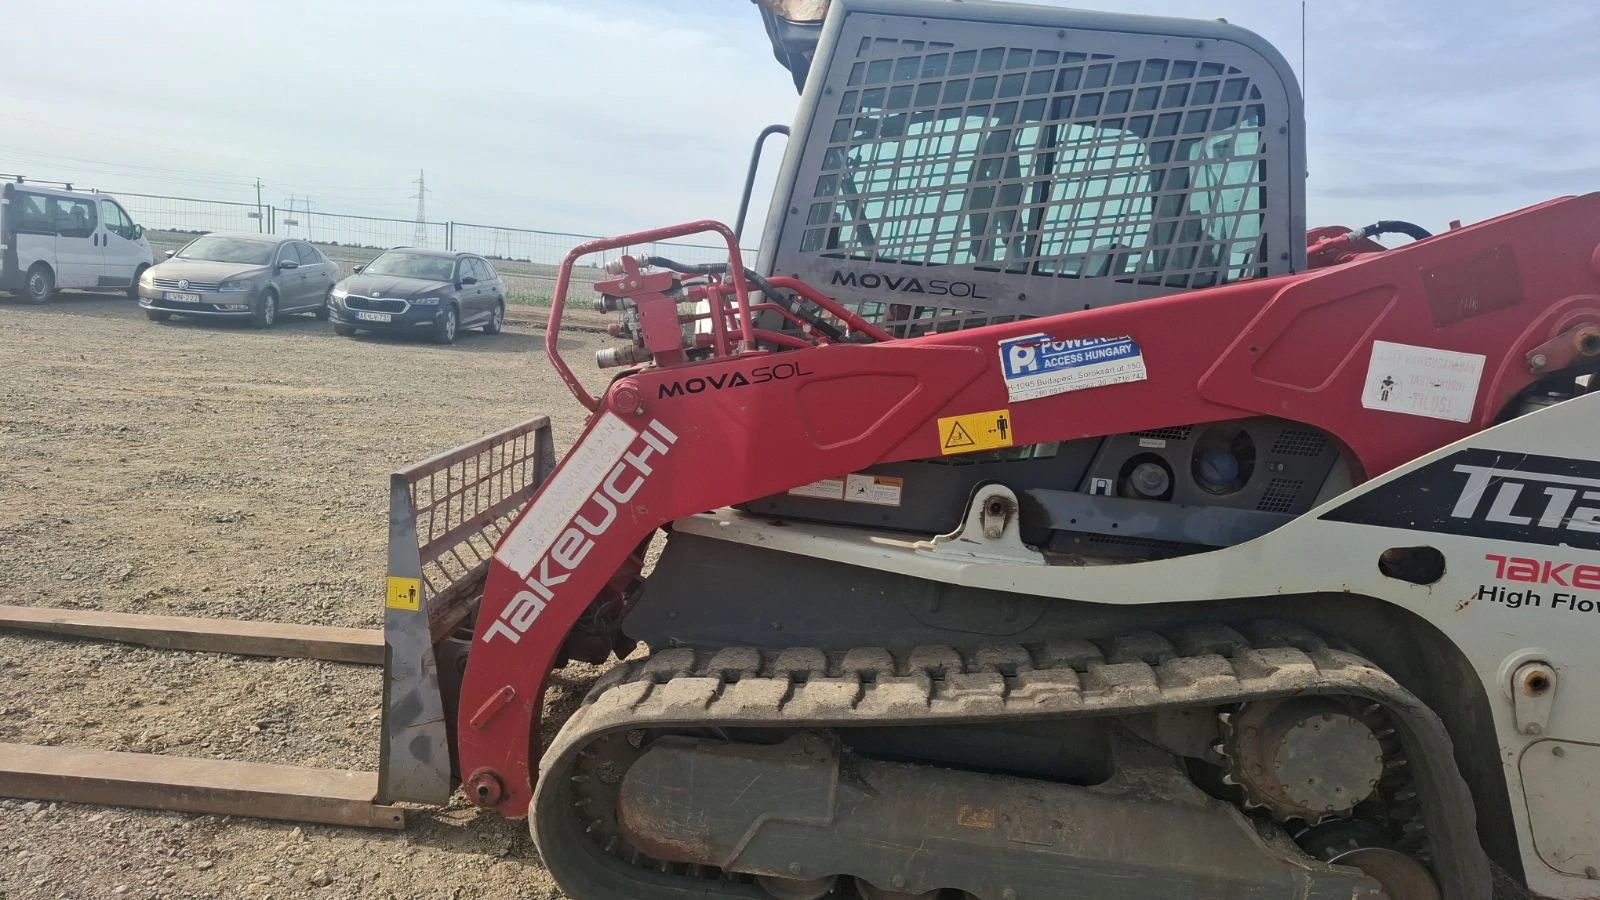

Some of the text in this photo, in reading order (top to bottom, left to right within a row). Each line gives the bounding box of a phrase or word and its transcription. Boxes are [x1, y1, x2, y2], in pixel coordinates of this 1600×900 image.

[831, 270, 988, 299] MOVASOL
[1044, 344, 1132, 368] ACCESS HUNGARY
[658, 362, 813, 399] MOVASOL
[1477, 585, 1600, 613] High Flo
